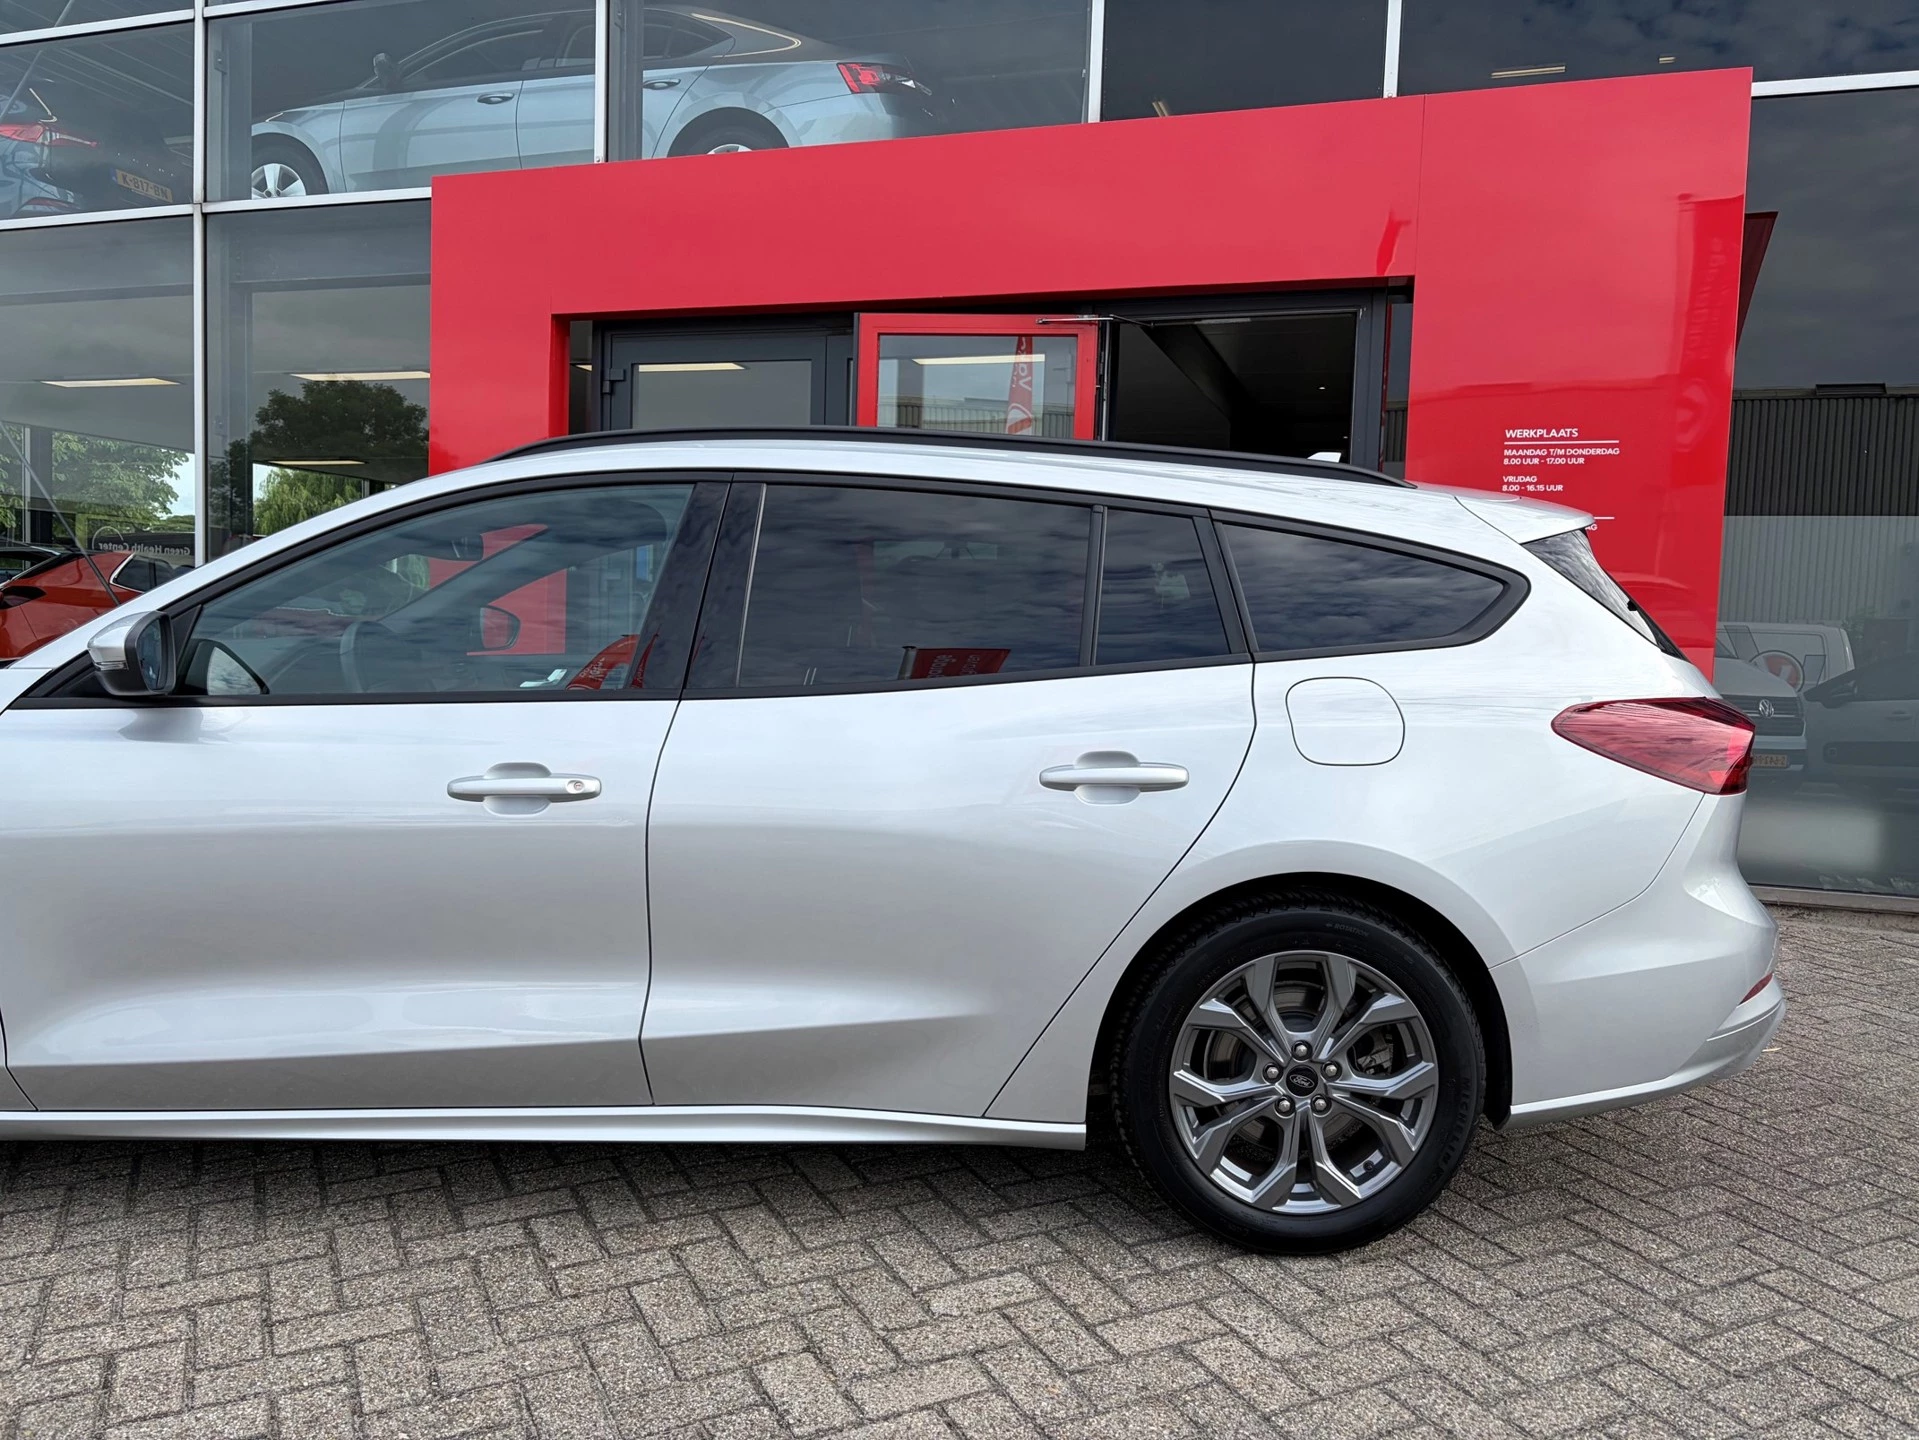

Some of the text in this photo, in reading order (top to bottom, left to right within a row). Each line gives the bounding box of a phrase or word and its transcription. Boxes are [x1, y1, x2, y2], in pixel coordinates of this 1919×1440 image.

[1505, 428, 1579, 438] WERKPLAATS
[1334, 923, 1370, 937] ROTATION
[1442, 1076, 1471, 1164] MICHELIN
